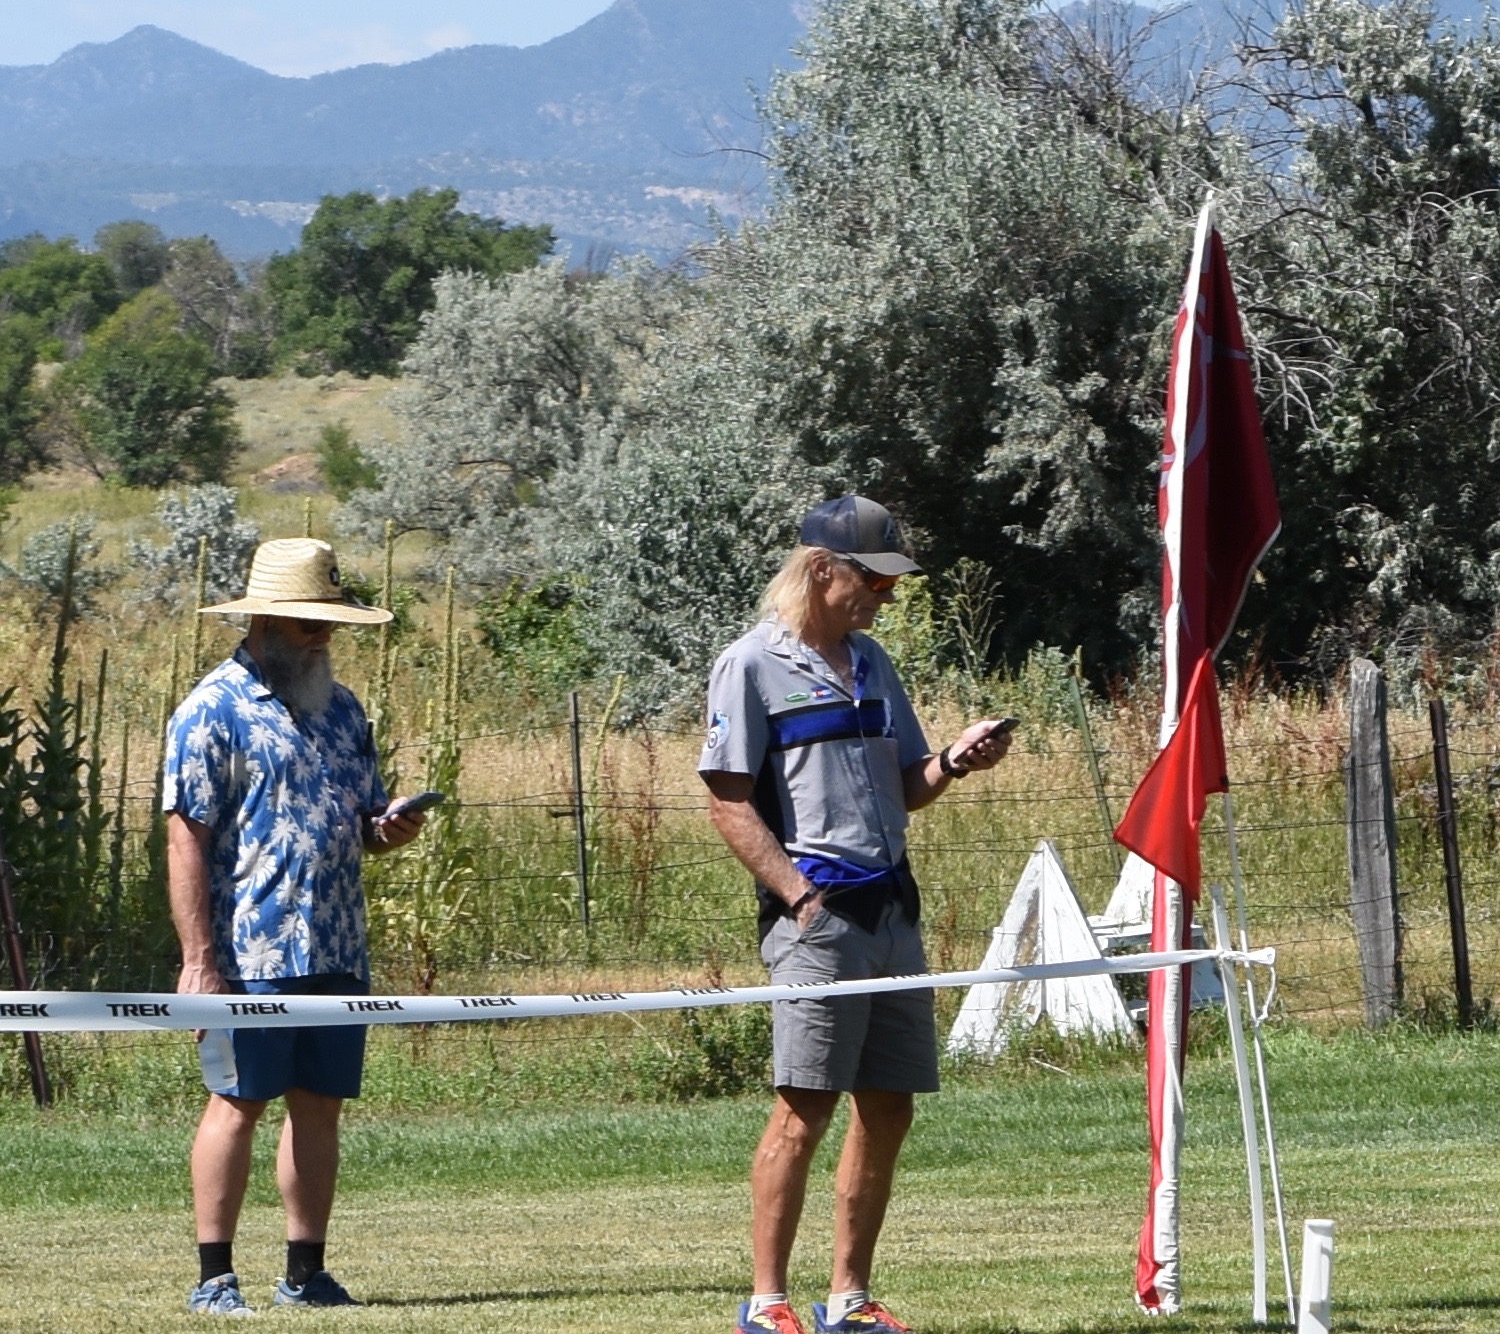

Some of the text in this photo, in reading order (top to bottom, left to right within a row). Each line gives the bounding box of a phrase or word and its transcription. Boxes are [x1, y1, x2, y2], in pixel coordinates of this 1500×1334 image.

[0, 1003, 50, 1018] REK
[105, 1003, 171, 1017] TREK
[225, 1002, 290, 1016] TREK
[341, 1000, 404, 1013] TREK
[455, 996, 518, 1007] TREK
